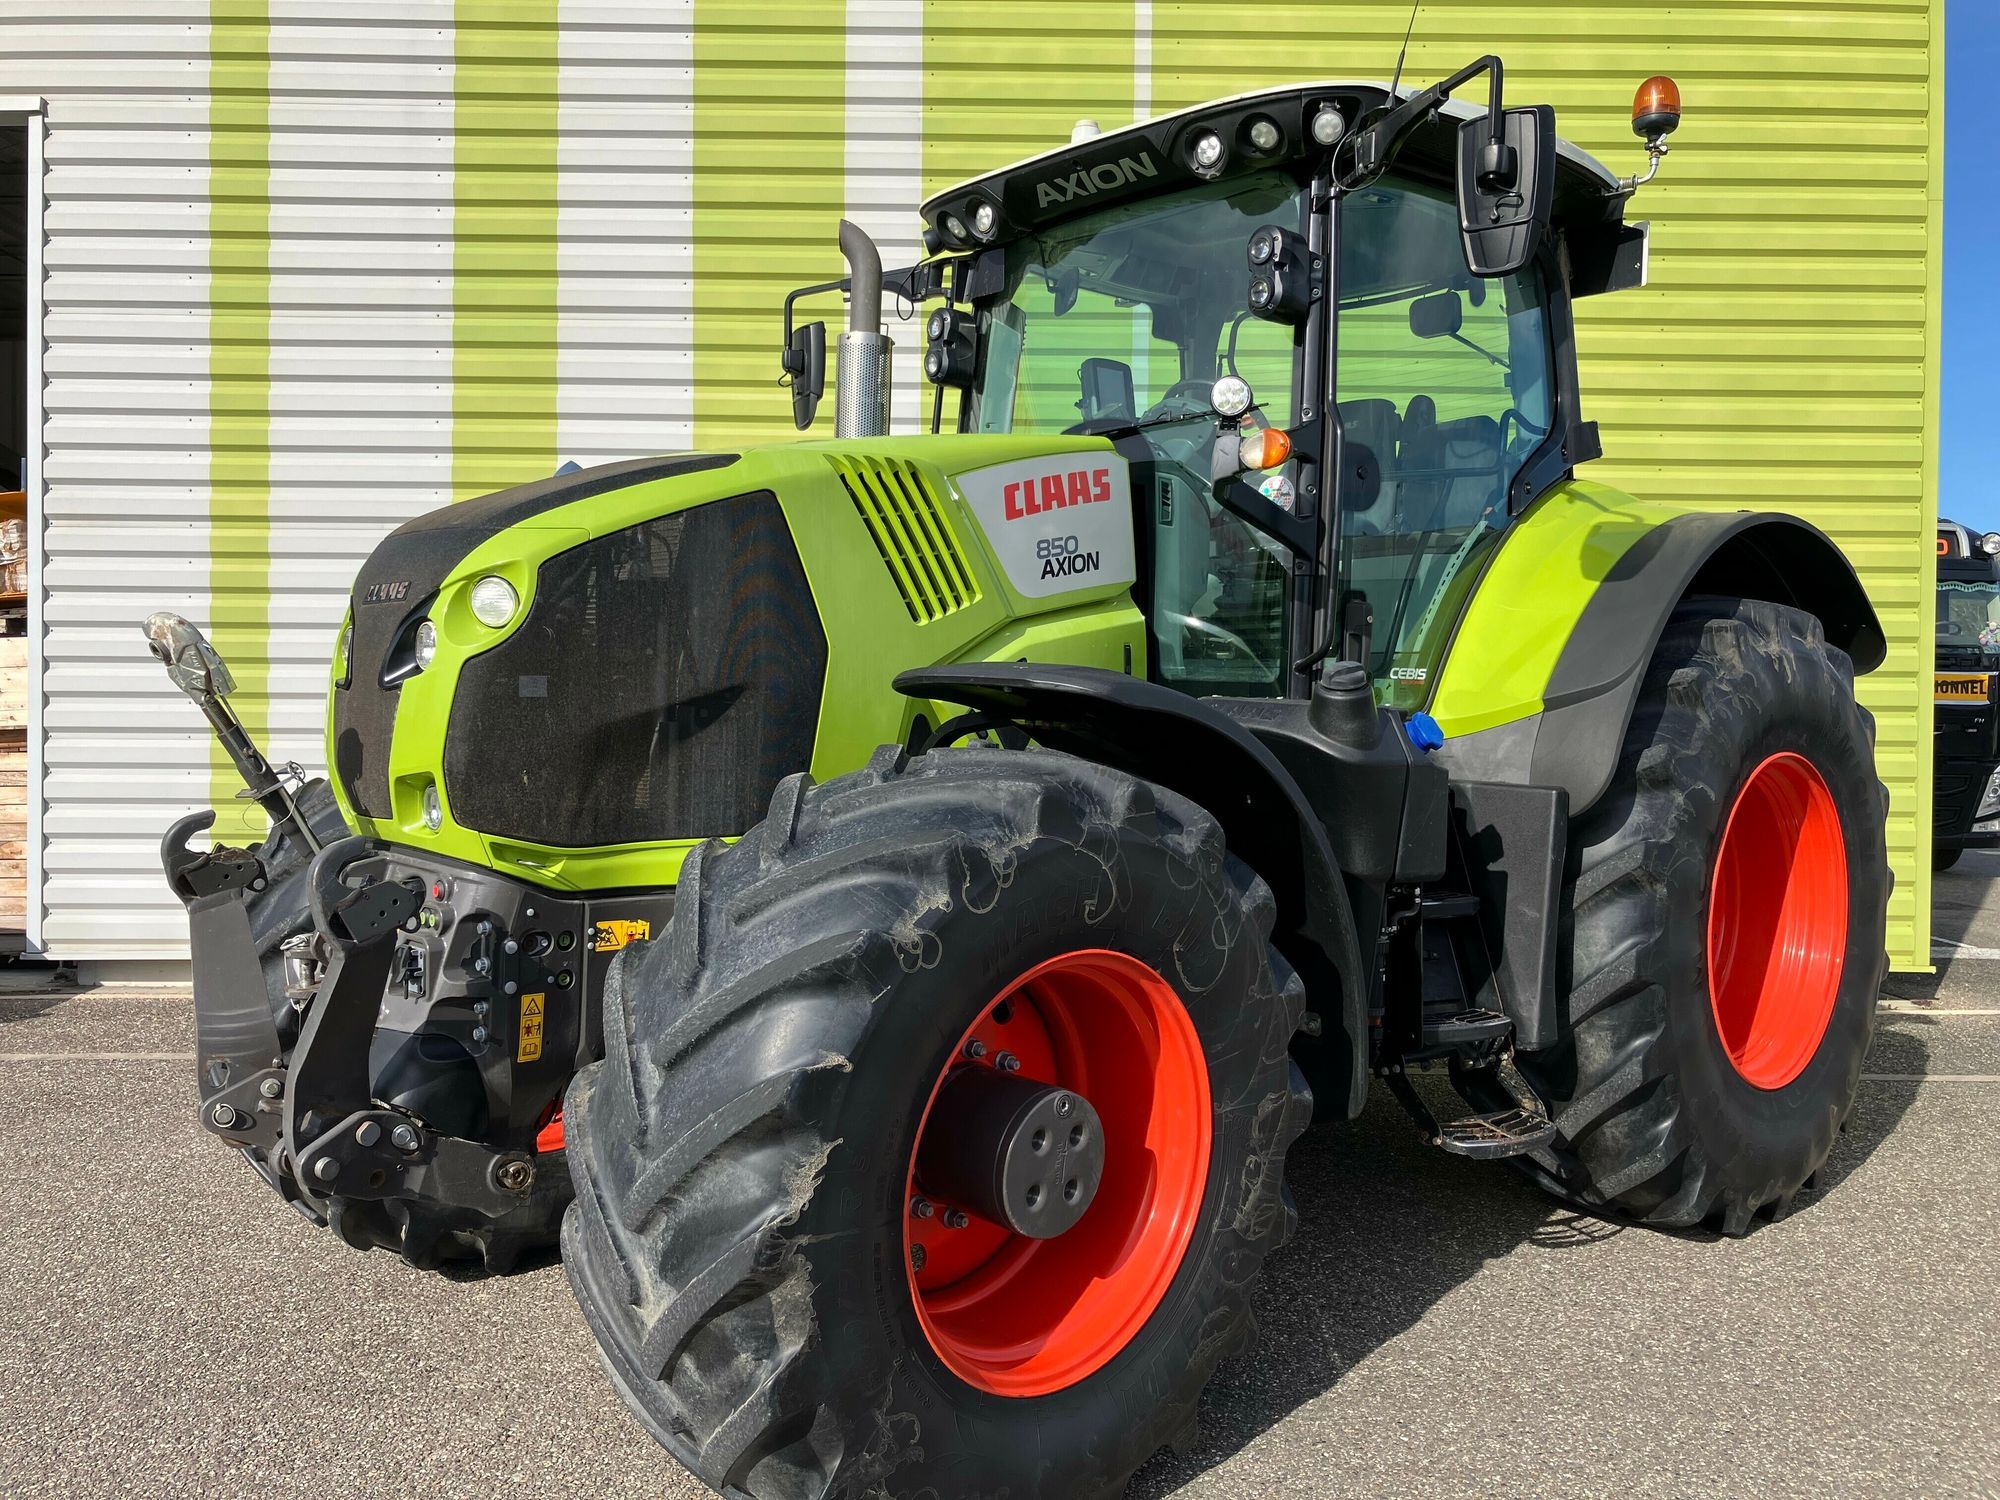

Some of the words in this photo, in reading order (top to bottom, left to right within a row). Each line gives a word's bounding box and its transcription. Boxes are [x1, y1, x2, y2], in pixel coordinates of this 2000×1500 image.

[1036, 151, 1159, 209] AXION
[1003, 468, 1111, 522] CLAAS
[1036, 534, 1079, 560] 850
[1040, 551, 1100, 580] AXION
[1389, 667, 1428, 680] CEBIS
